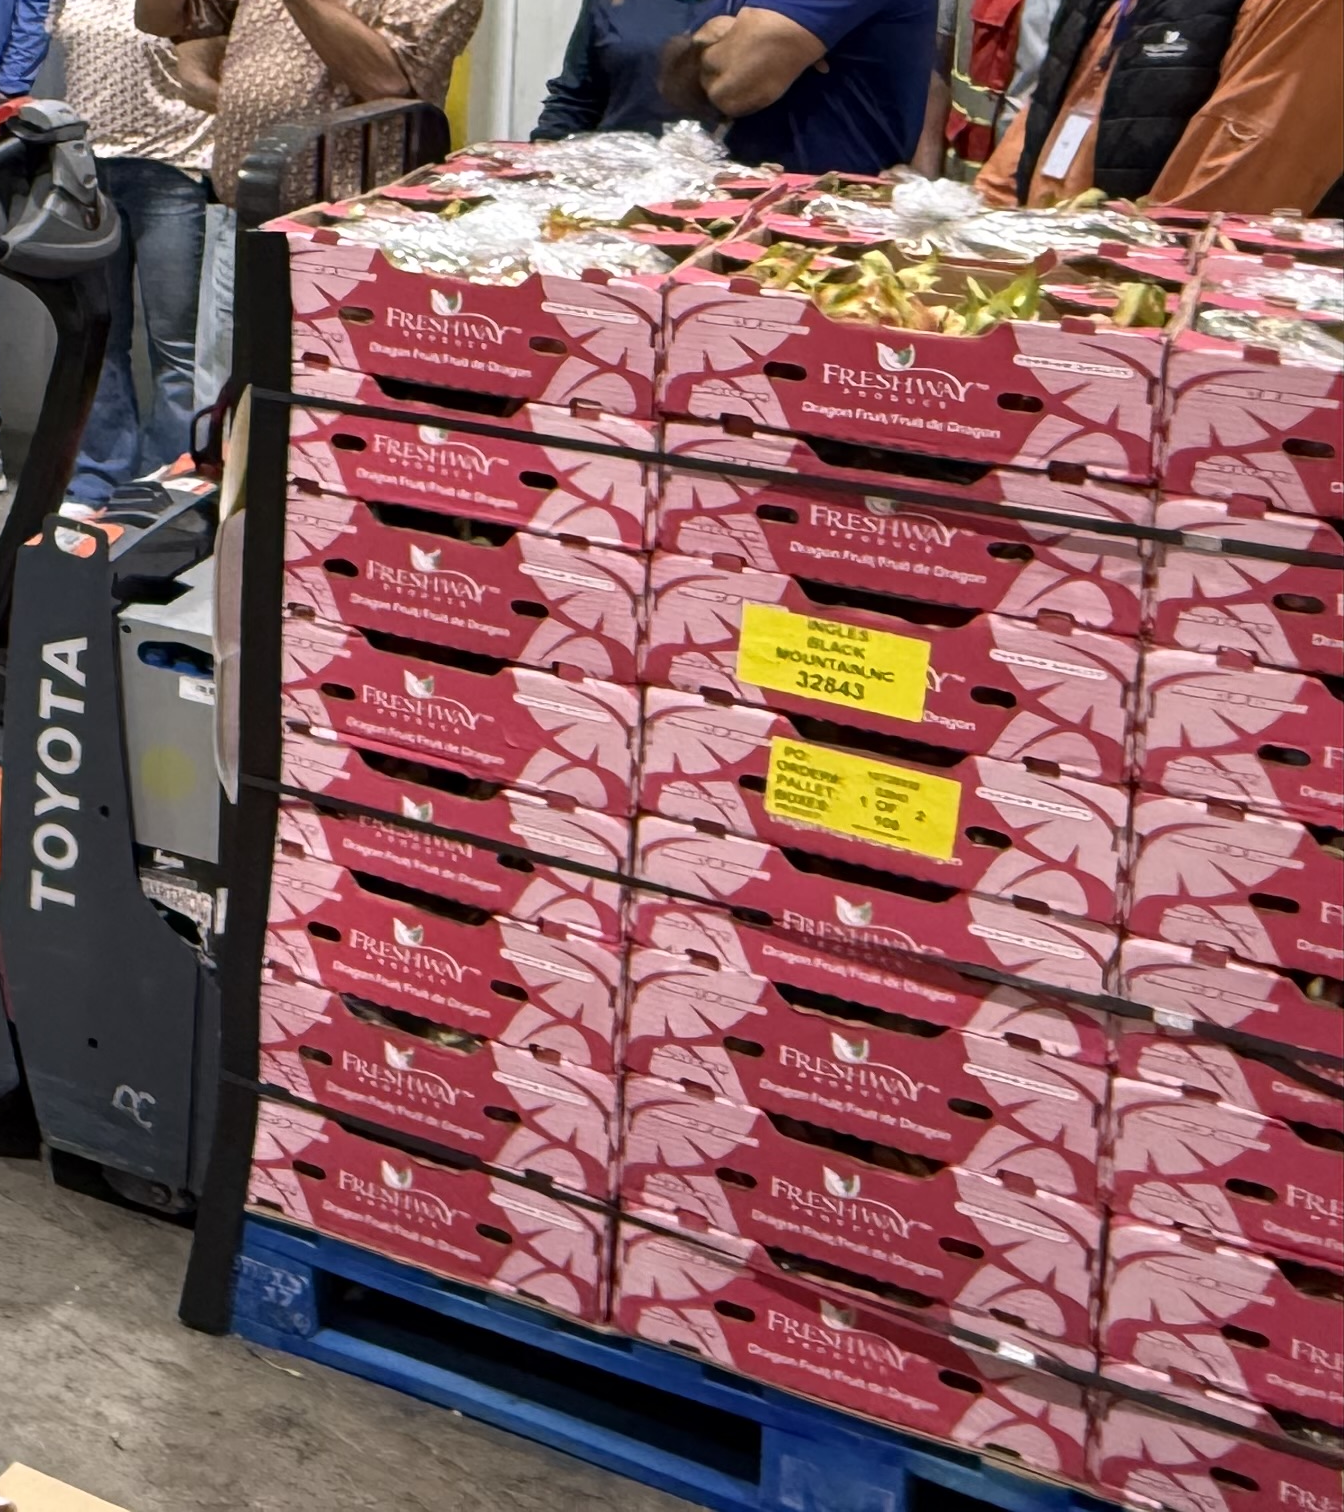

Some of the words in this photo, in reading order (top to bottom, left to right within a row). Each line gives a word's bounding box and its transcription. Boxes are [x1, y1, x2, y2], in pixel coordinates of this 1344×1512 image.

[387, 306, 509, 345] FRESHWAY
[822, 363, 972, 402] FRESHWAY
[373, 434, 496, 476] FRESHWAY
[810, 504, 958, 547] FRESHWAY
[366, 560, 488, 604] FRESHWAY
[807, 637, 866, 659] BLACK
[362, 684, 480, 730] FRESHWAY
[796, 670, 865, 700] 32843
[30, 637, 88, 912] TOYOTA
[349, 929, 467, 983] FRESHWAY
[779, 1045, 924, 1101] FRESHWAY
[771, 1176, 914, 1239] FRESHWAY
[767, 1309, 910, 1371] FRESHWAY
